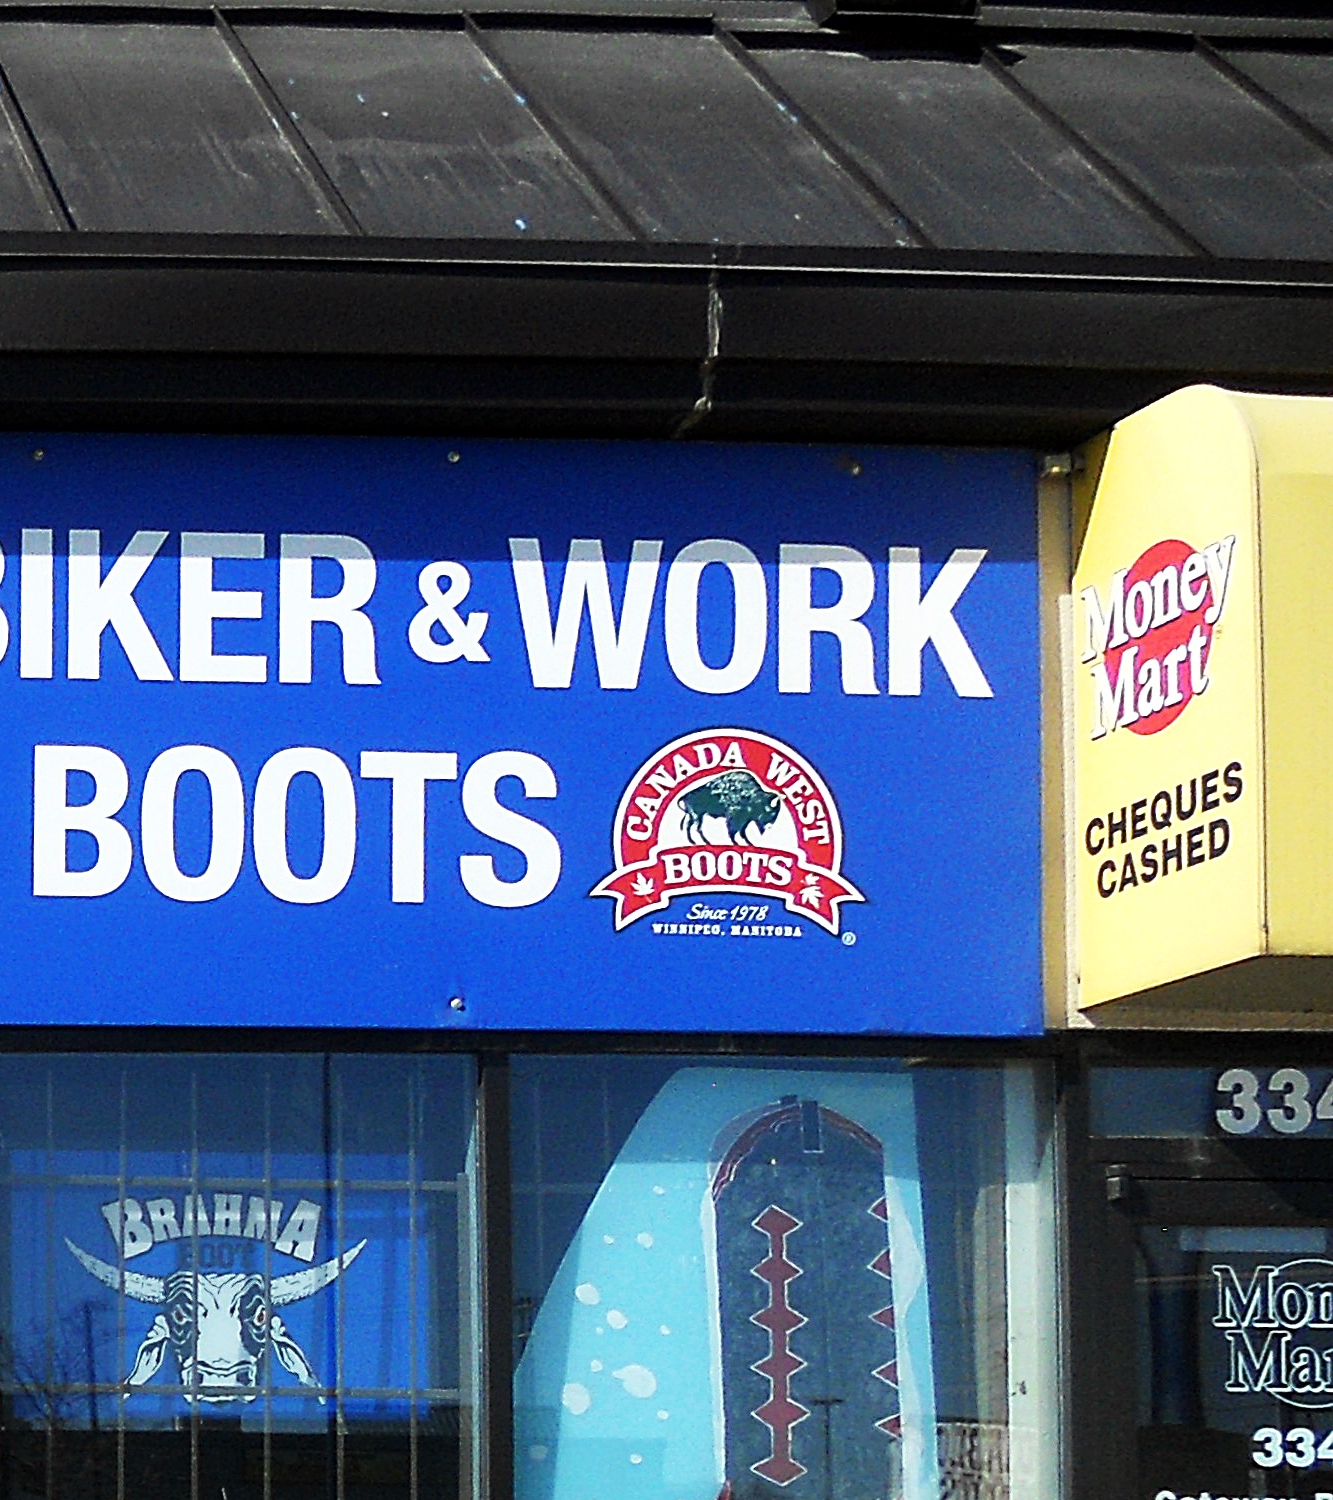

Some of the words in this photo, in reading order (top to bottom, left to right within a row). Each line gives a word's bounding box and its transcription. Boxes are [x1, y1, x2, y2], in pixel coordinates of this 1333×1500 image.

[408, 560, 491, 665] &
[508, 537, 995, 699] WORK
[1080, 534, 1237, 664] Money
[1089, 623, 1211, 741] Mart
[31, 742, 562, 908] BOOTS
[626, 740, 747, 842] CANADA
[766, 752, 830, 846] WEST
[1085, 761, 1244, 856] CHEQUES
[661, 850, 794, 887] BOOTS
[1096, 817, 1231, 900] CASHED
[730, 904, 769, 921] 1978
[100, 1193, 322, 1263] BRAHMA
